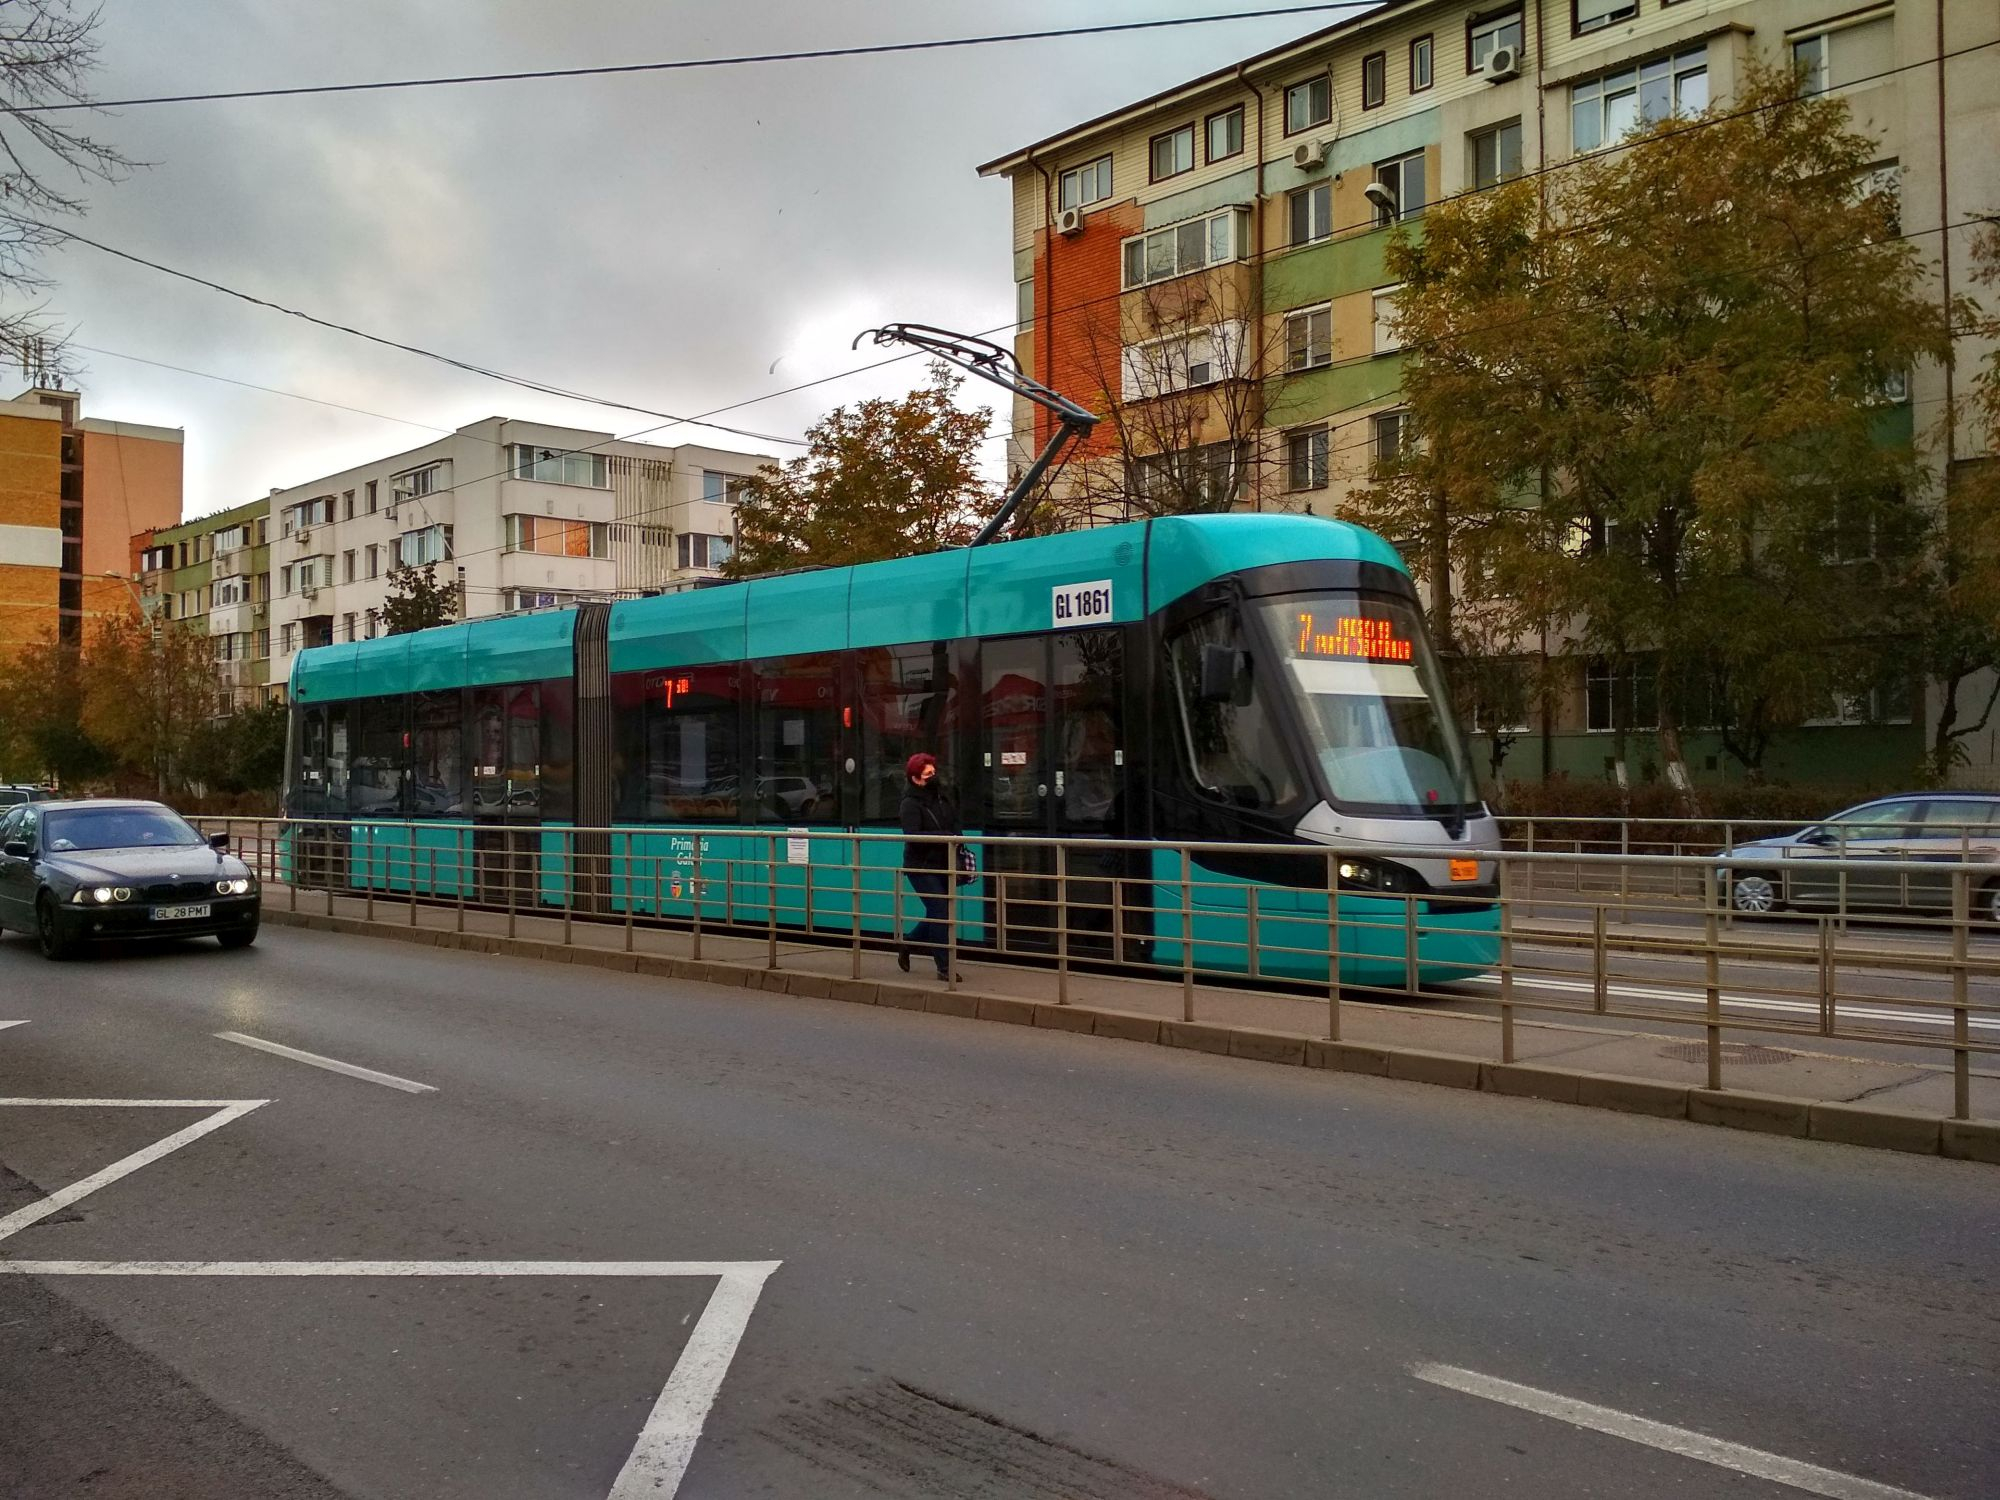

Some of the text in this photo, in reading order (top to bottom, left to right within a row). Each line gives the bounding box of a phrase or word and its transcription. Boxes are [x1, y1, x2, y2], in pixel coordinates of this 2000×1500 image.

[1056, 588, 1109, 619] GL 1861
[1300, 613, 1312, 653] 7
[671, 837, 709, 852] Primia
[676, 852, 703, 866] Gali
[156, 905, 209, 919] GL 28 PMT
